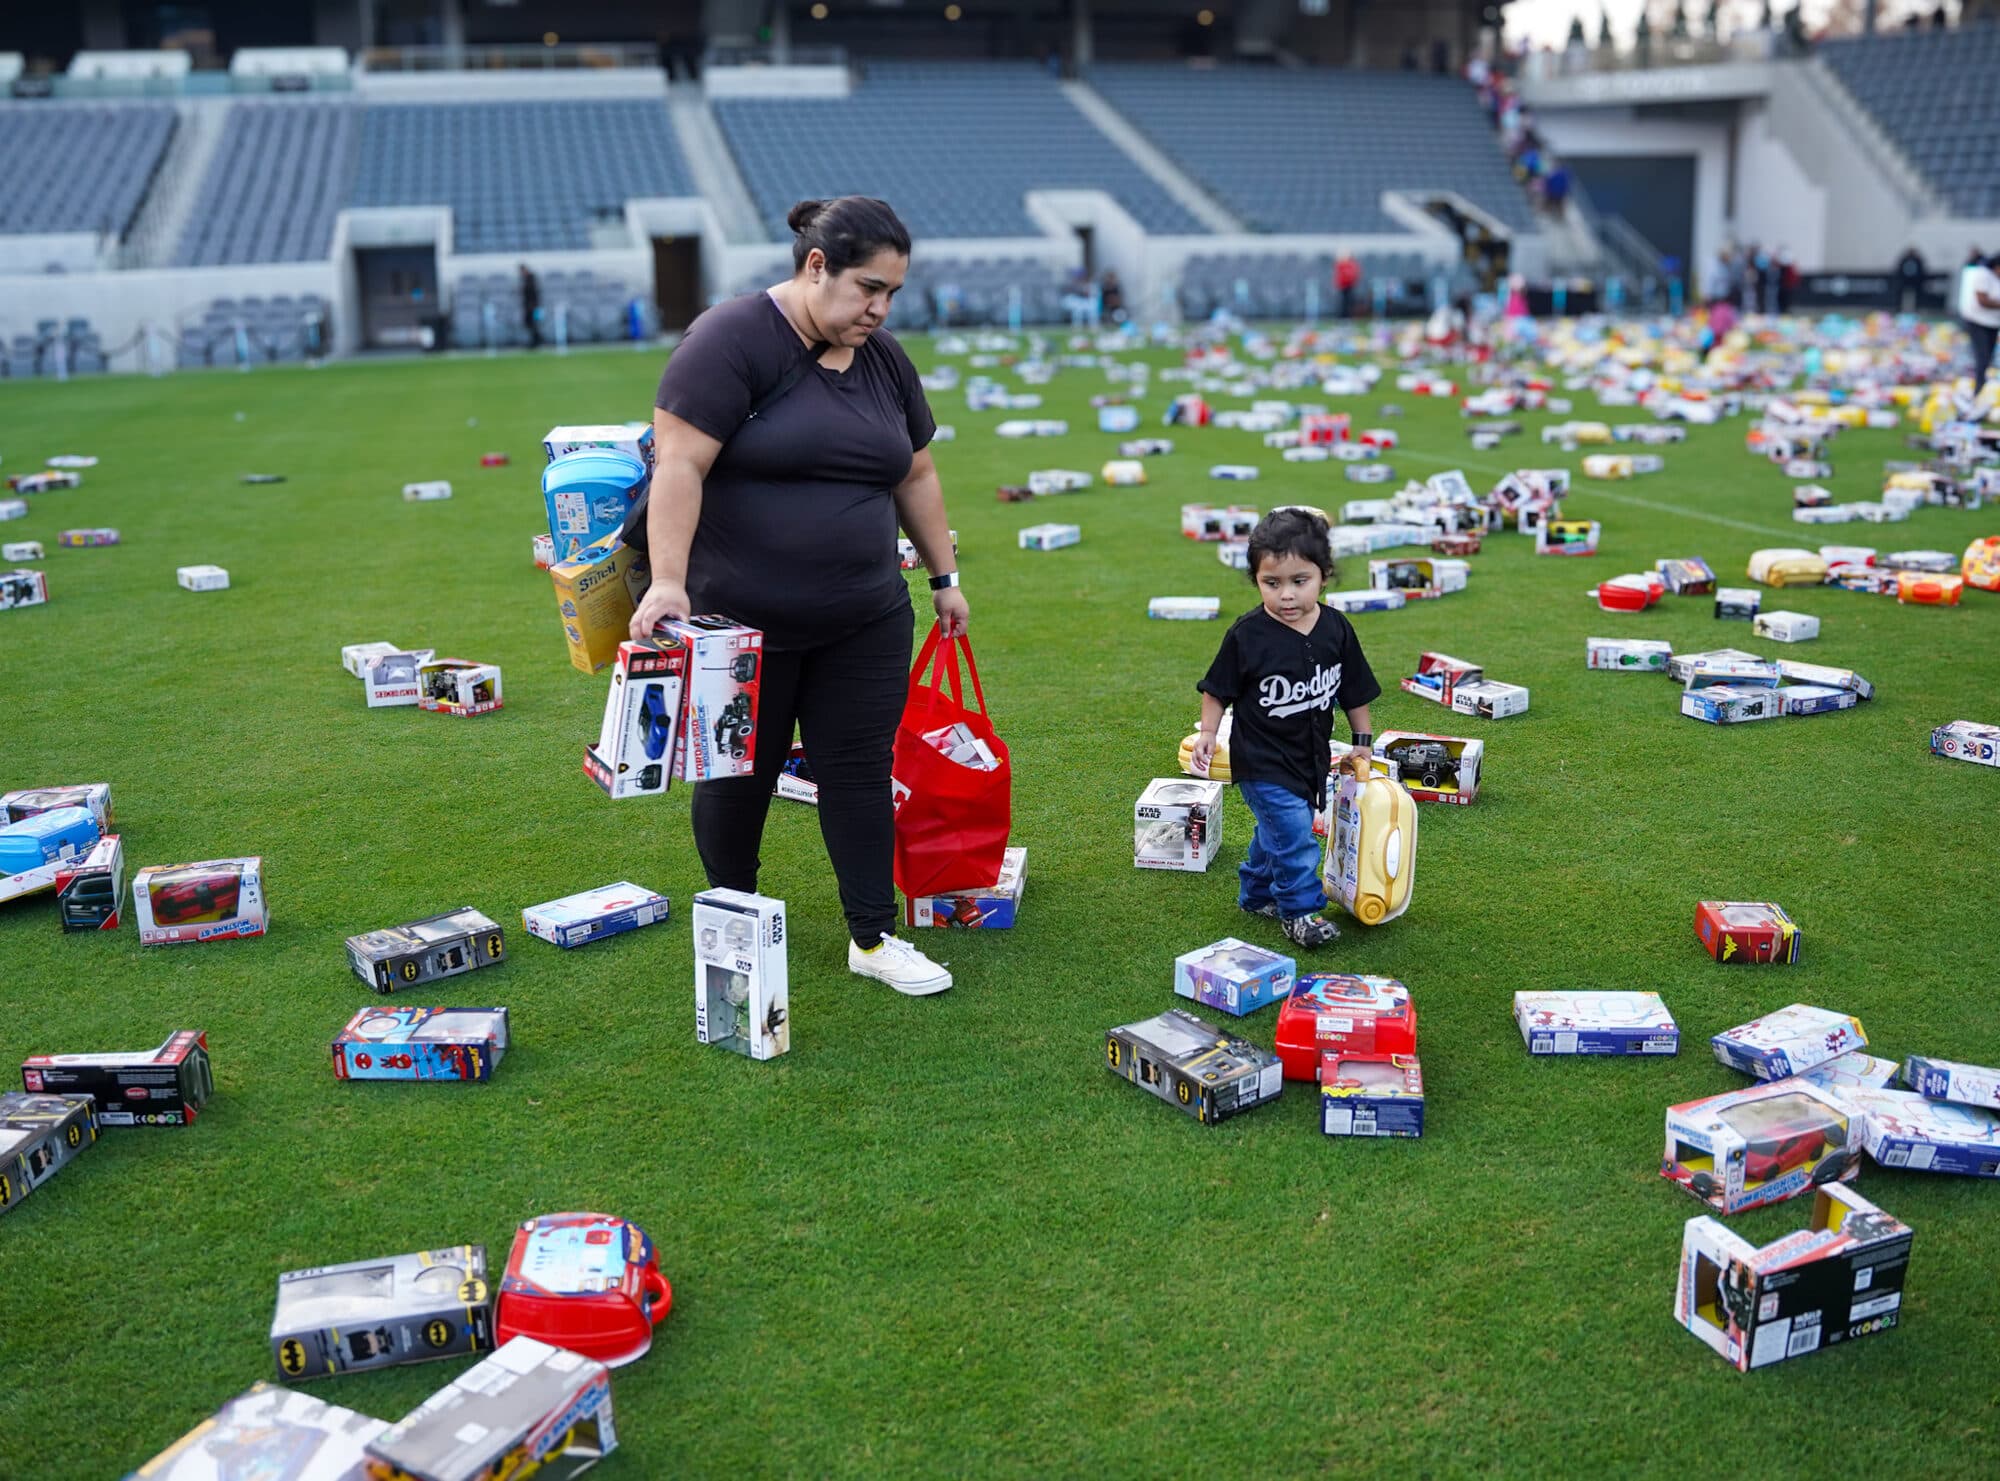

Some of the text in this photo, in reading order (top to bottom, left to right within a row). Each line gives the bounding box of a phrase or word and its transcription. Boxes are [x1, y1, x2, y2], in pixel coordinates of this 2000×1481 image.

[375, 688, 417, 699] RANSFORMERS
[1259, 663, 1342, 711] Dodger
[200, 919, 249, 937] MUSTANG GT
[239, 923, 260, 933] FORD
[1729, 1168, 1803, 1210] LAMBORGHINI
